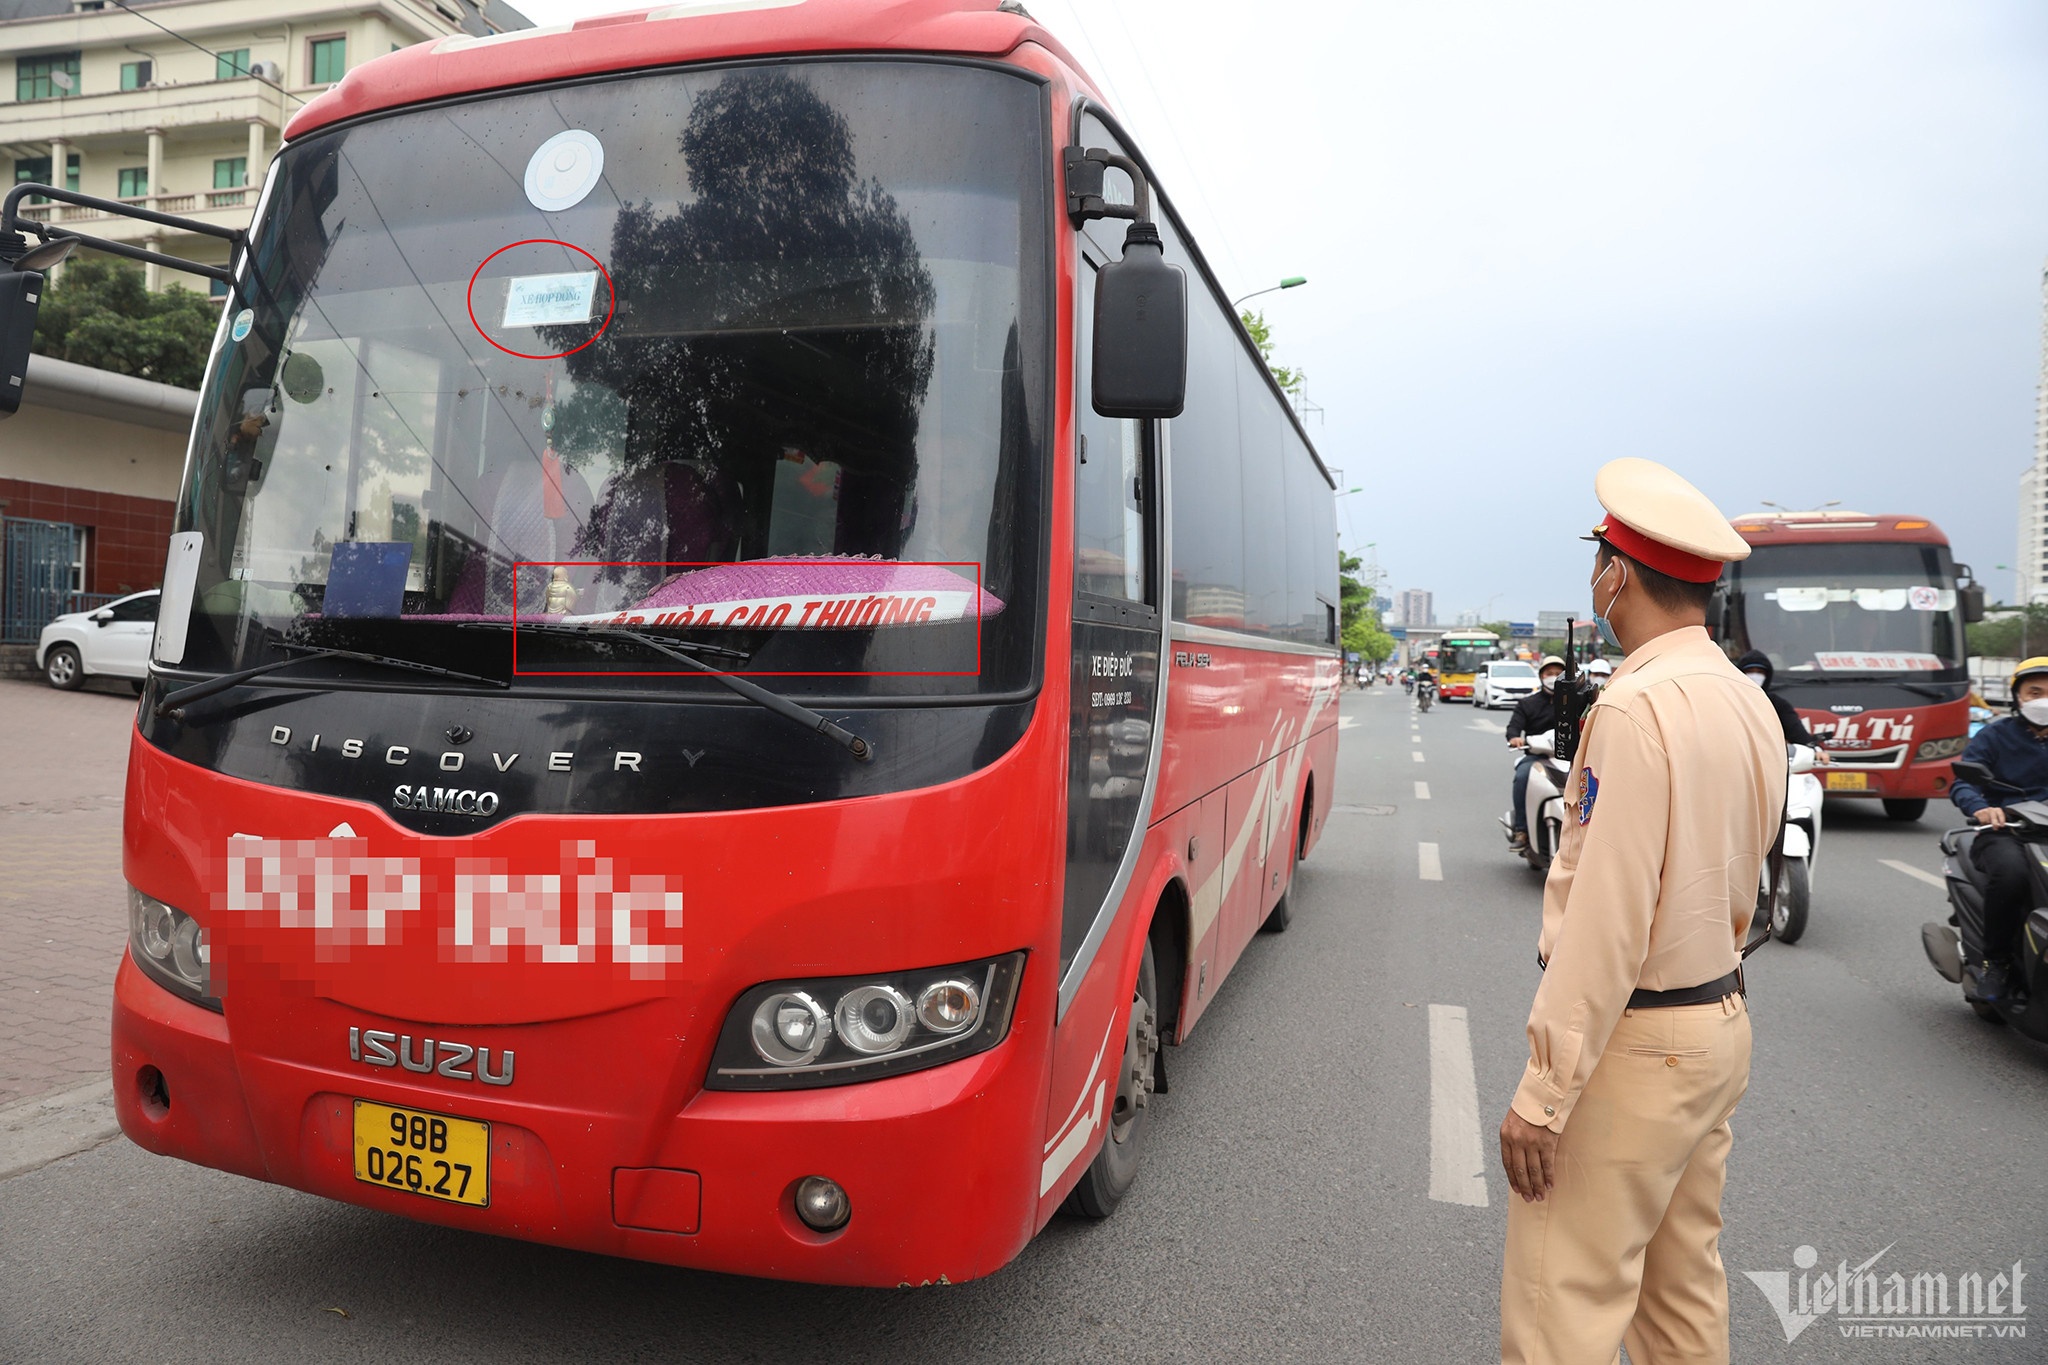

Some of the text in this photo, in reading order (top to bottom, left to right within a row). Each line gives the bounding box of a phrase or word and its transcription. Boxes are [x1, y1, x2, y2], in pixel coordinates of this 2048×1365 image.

[1091, 656, 1102, 677] XE
[1866, 714, 1914, 741] Tú
[393, 784, 499, 817] SAMCO
[349, 1026, 514, 1086] ISUZU
[390, 1112, 448, 1154] 98B
[367, 1146, 472, 1198] 026.27
